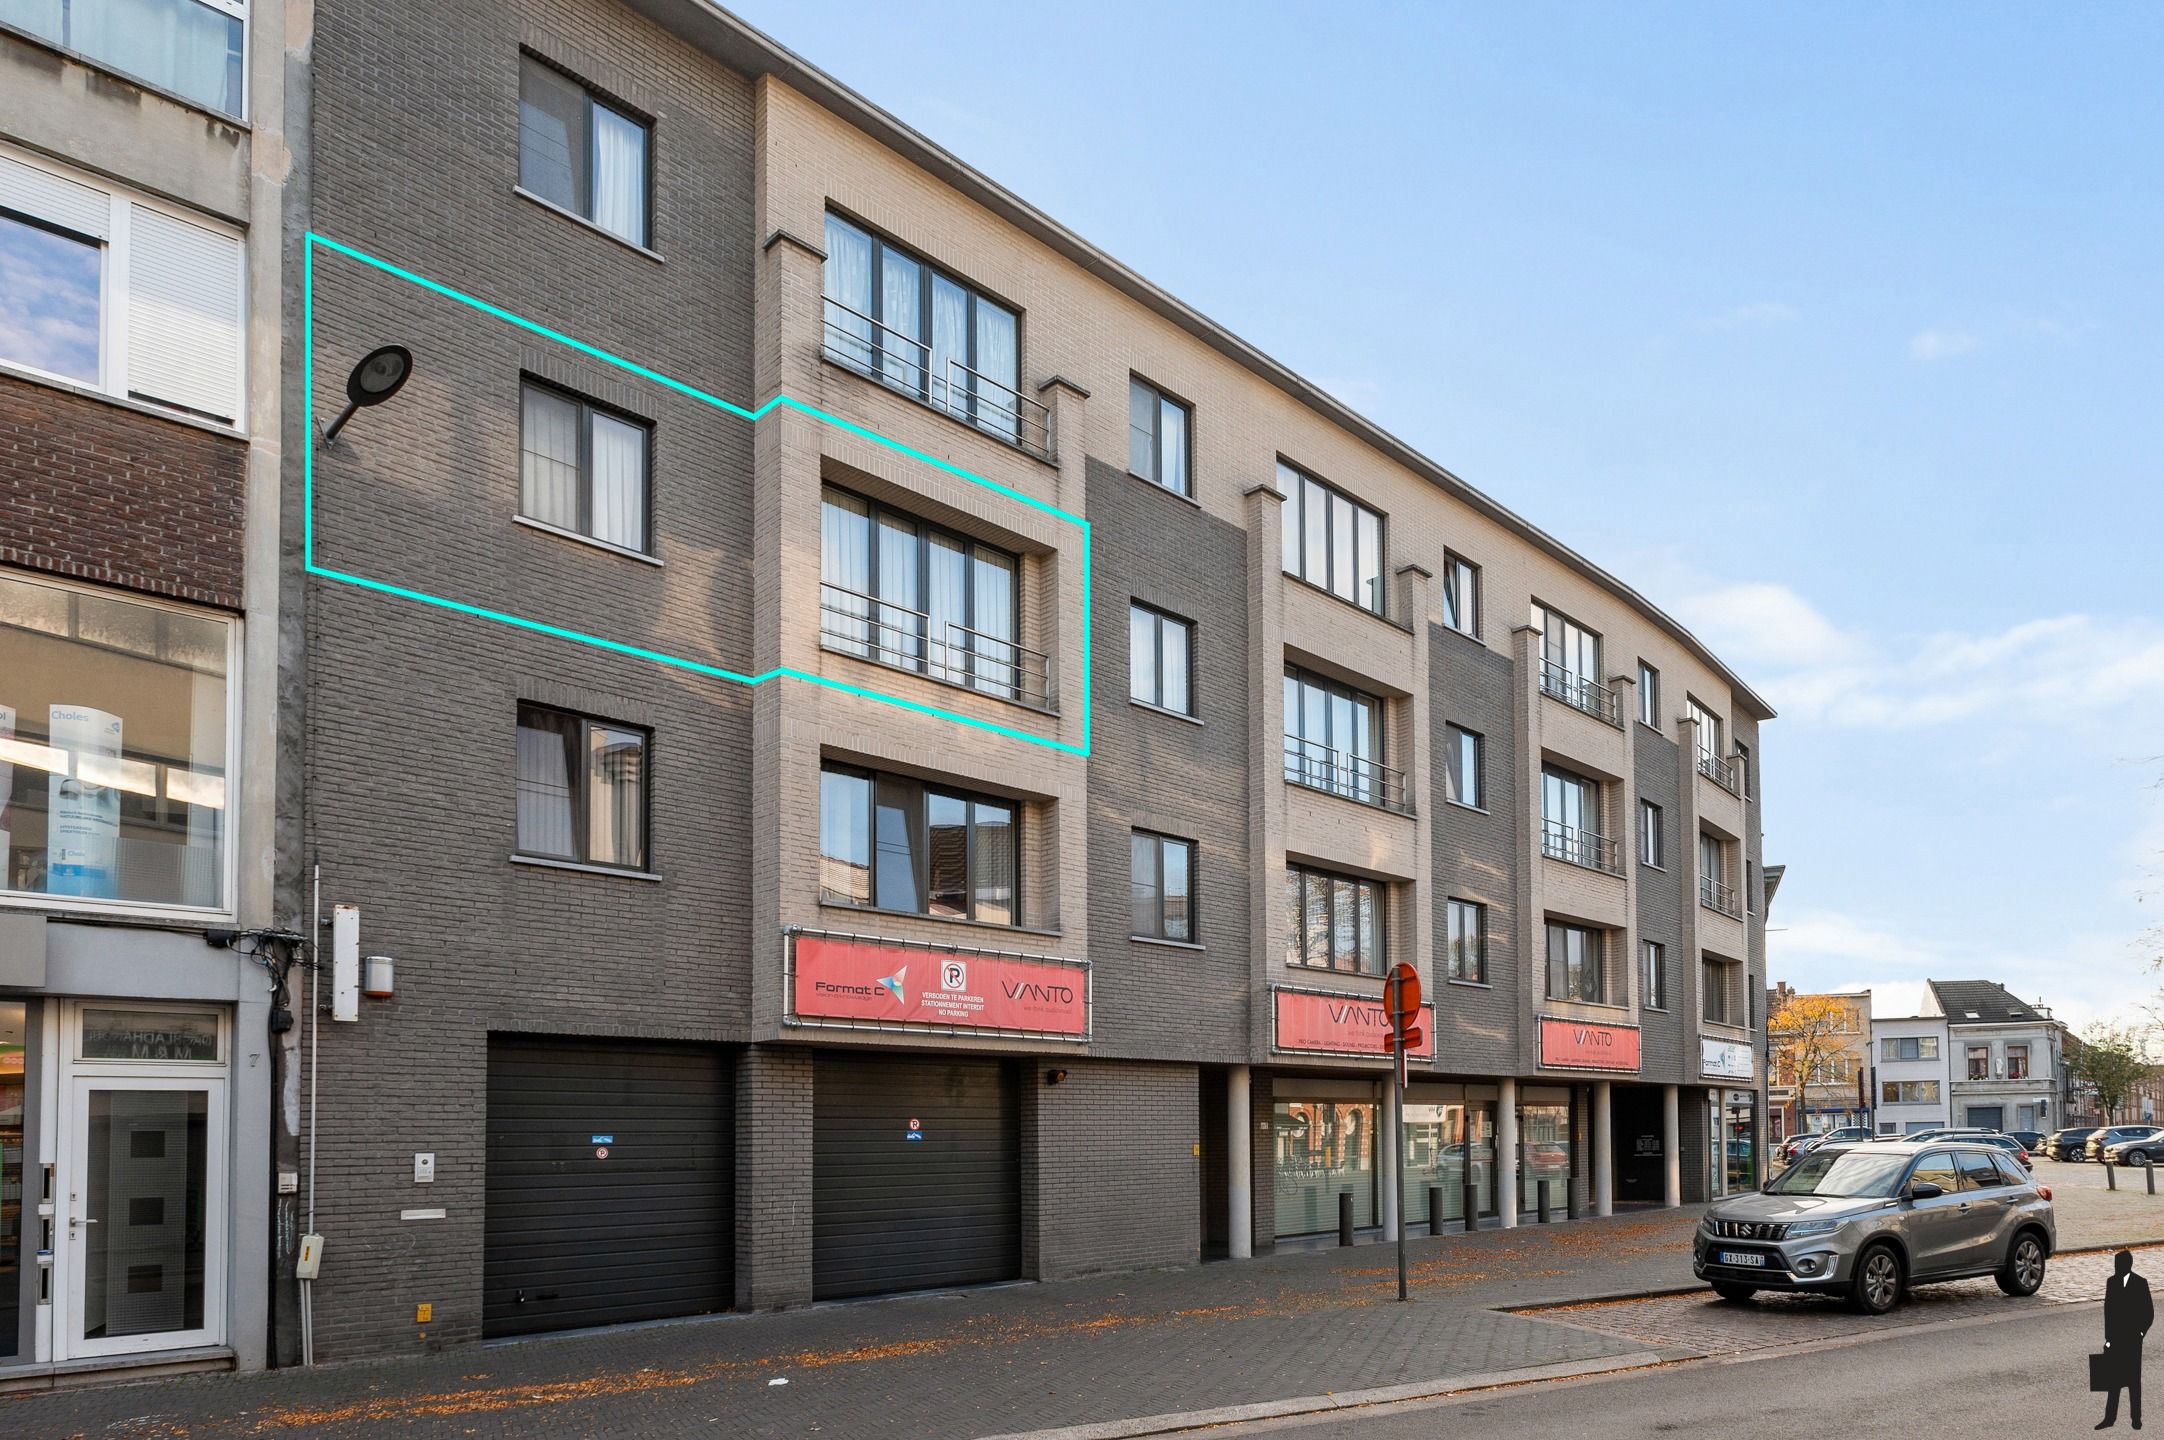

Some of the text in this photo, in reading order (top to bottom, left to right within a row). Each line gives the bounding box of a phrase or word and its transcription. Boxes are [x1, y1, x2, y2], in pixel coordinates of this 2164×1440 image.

[816, 982, 885, 996] Format C
[922, 992, 950, 1000] VERBODEN
[958, 994, 984, 1002] PARKEREN
[921, 1000, 984, 1011] STATIONNEMENT INTERDIT
[947, 1010, 968, 1018] PARKING
